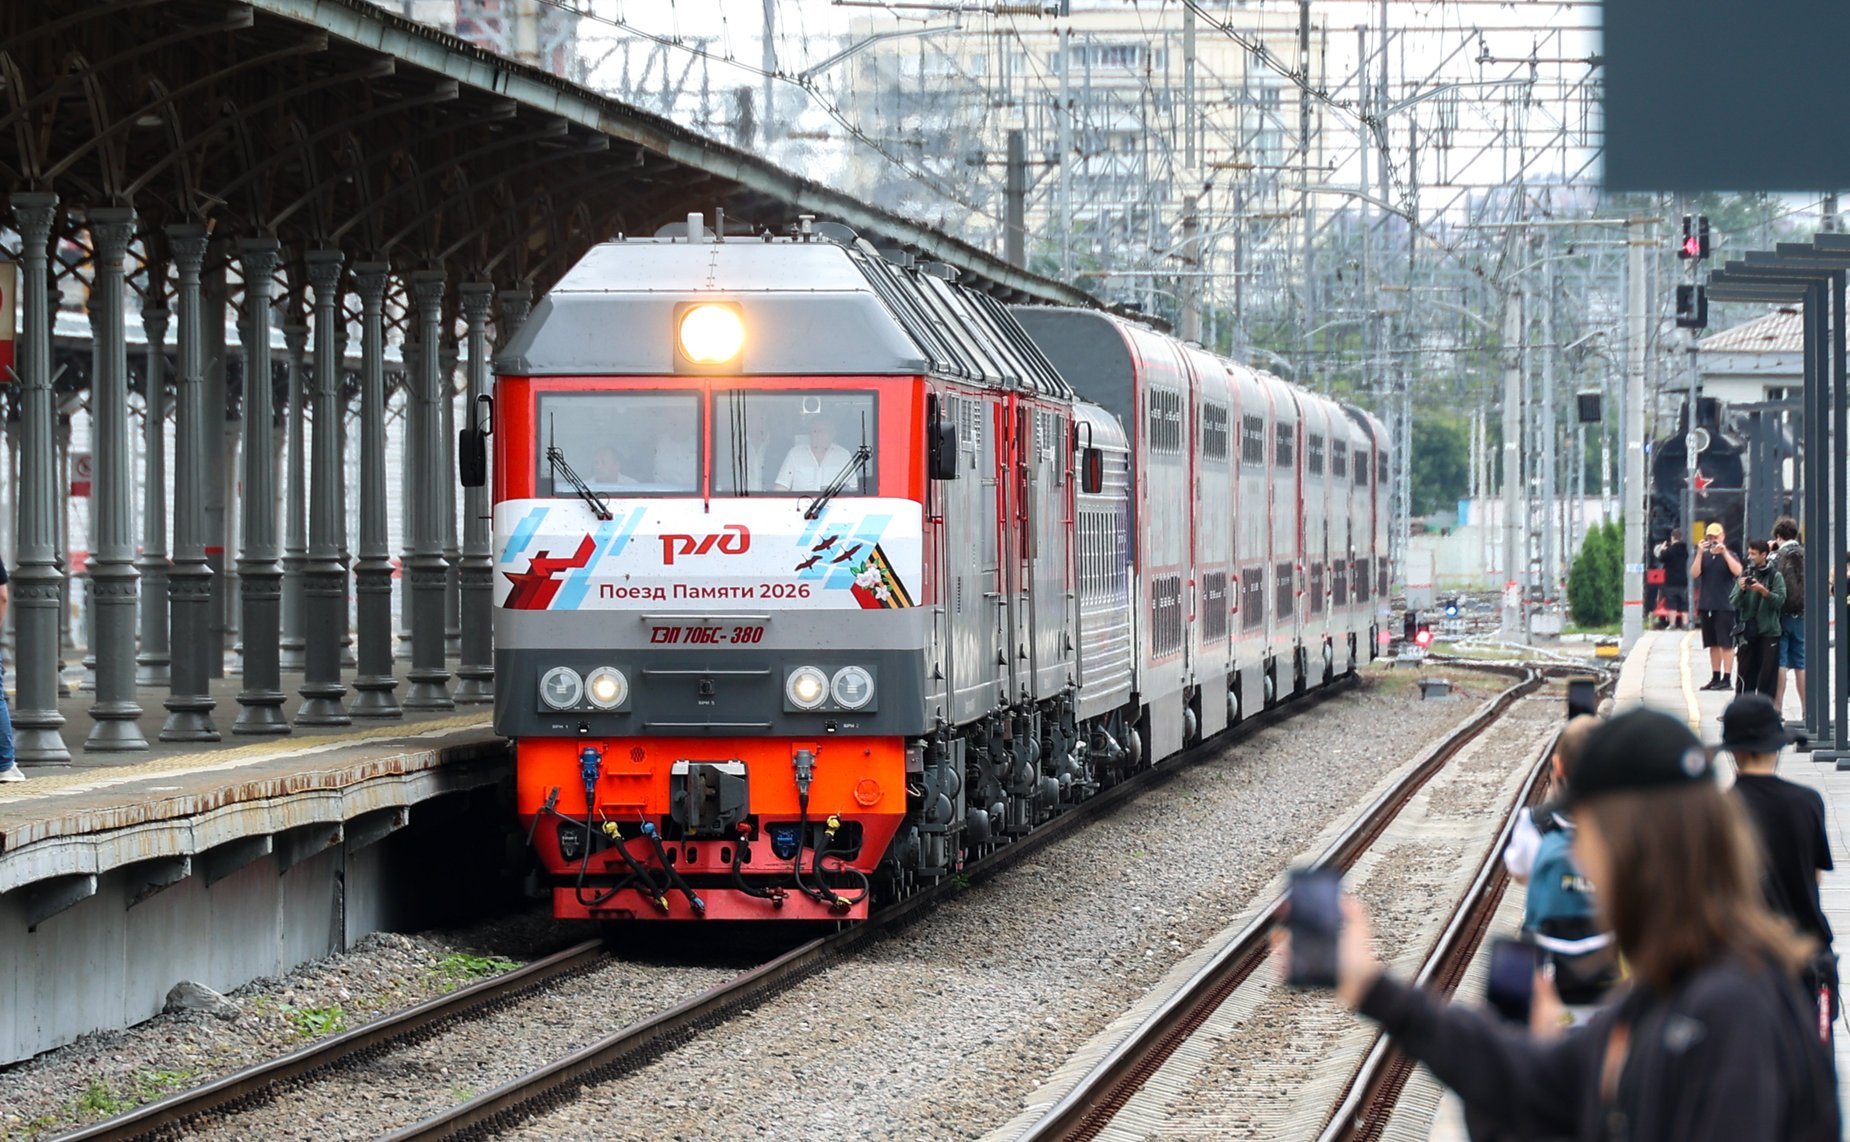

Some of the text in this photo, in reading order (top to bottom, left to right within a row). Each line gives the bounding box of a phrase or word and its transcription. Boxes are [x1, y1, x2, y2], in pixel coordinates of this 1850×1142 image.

[599, 583, 811, 600] Поезд Памяти 2026
[650, 626, 682, 644] ТЭП
